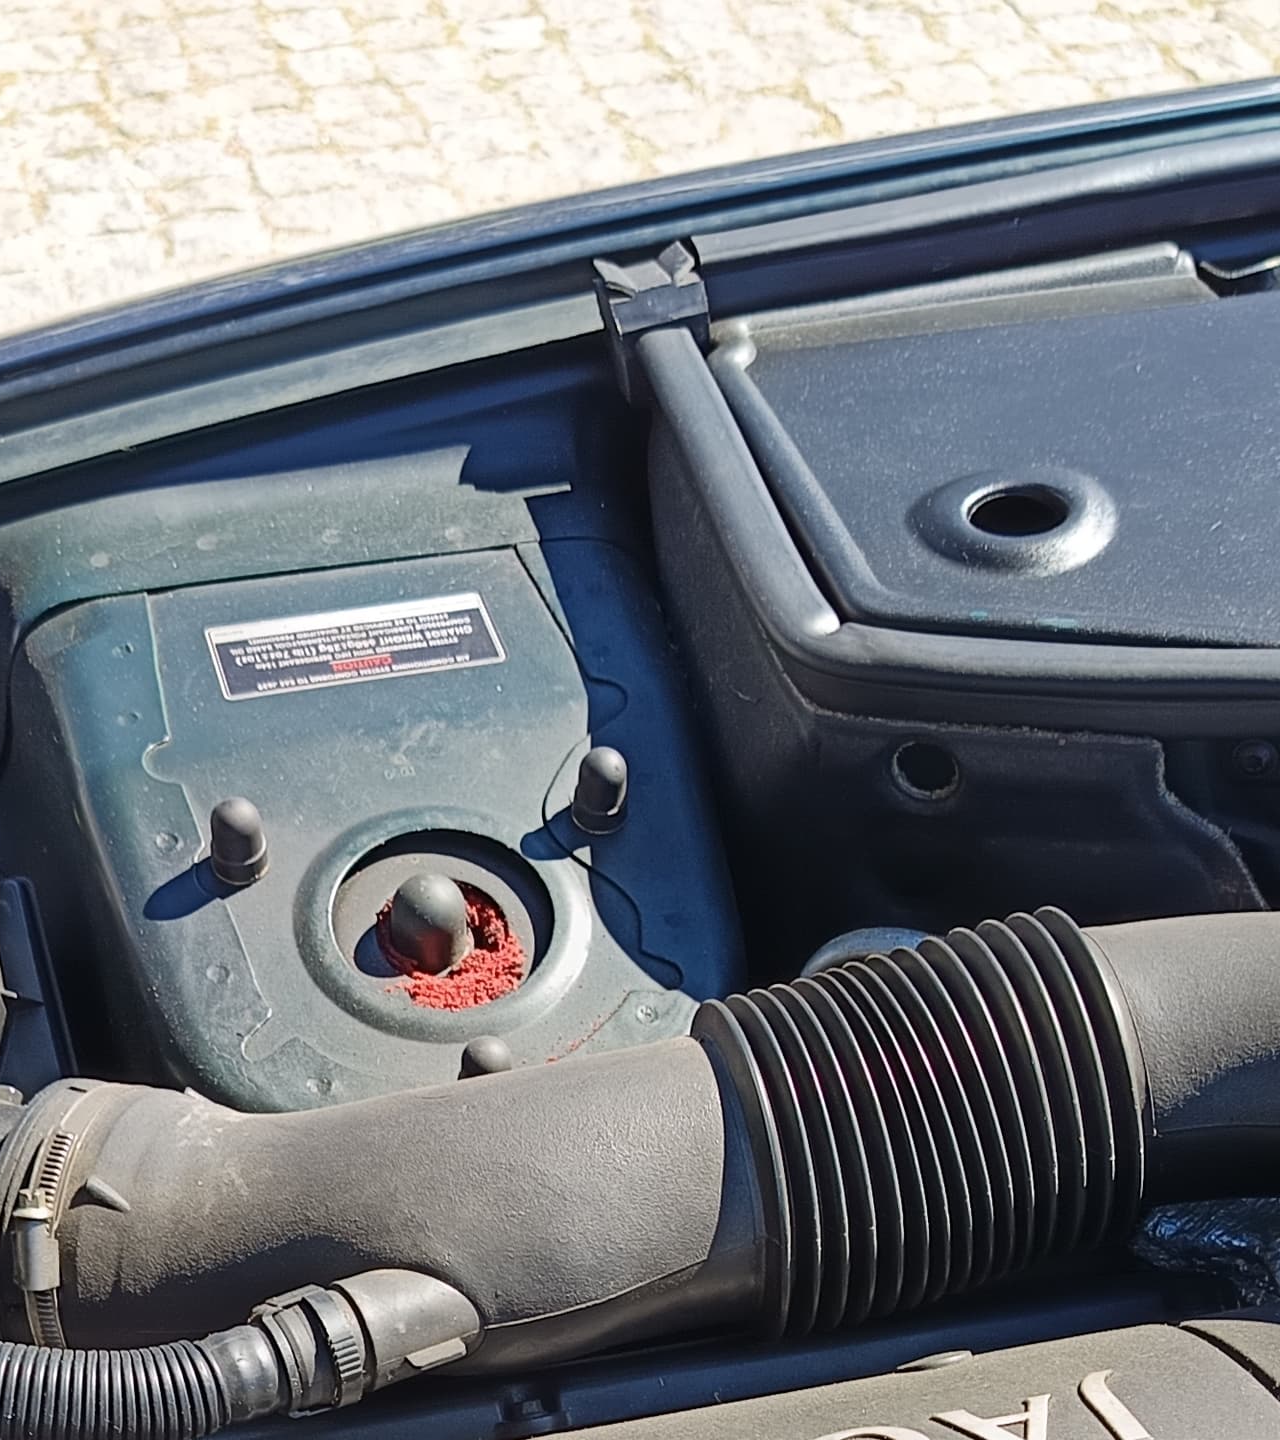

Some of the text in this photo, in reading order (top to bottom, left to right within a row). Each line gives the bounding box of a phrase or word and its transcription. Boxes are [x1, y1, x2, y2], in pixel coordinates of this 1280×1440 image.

[377, 631, 424, 645] WEIGHT
[423, 624, 474, 639] CHARGE
[330, 655, 393, 672] CAUTION
[296, 676, 308, 684] TO
